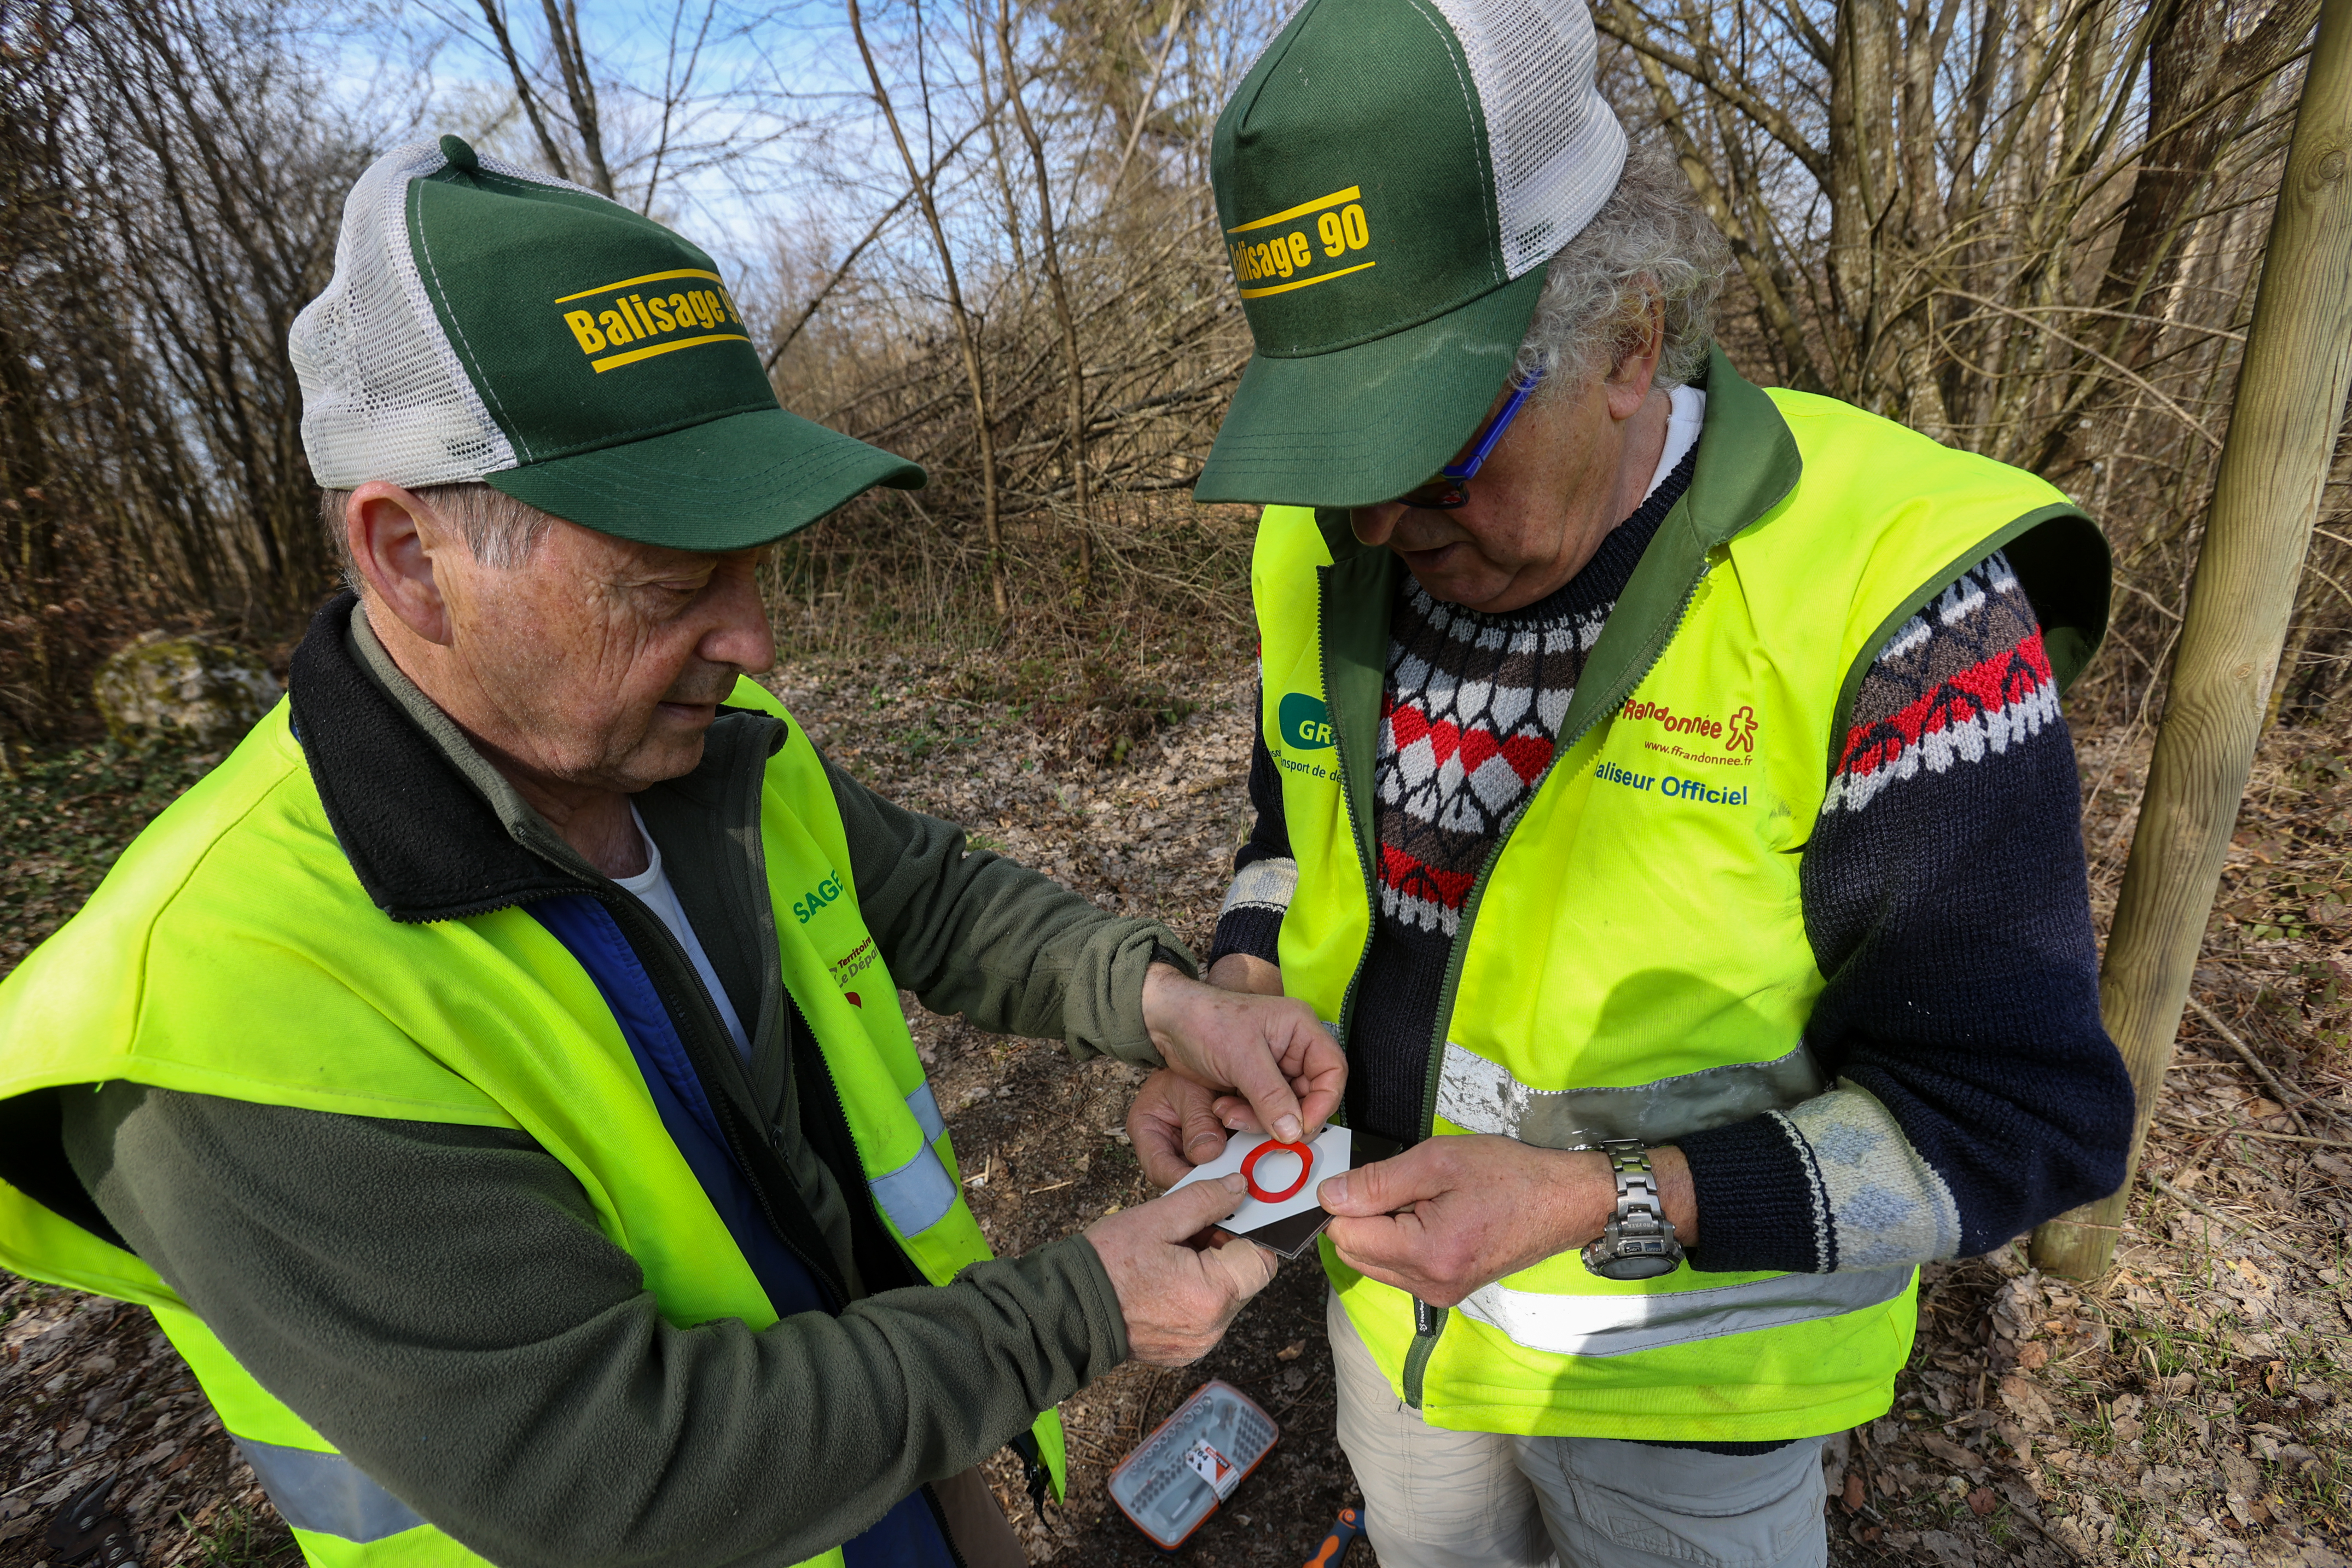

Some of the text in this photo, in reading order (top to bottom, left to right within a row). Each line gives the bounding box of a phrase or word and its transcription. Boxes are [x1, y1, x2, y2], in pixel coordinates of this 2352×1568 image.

[1318, 204, 1369, 257] 90
[564, 286, 743, 355] Balisage 9
[1299, 720, 1332, 744] GR
[1617, 698, 1722, 739] Randonnée
[1645, 741, 1753, 765] www.ffrandonnee.fr
[1312, 765, 1326, 778] de
[1594, 760, 1747, 805] aliseur Officiel
[837, 936, 872, 968] Territoire
